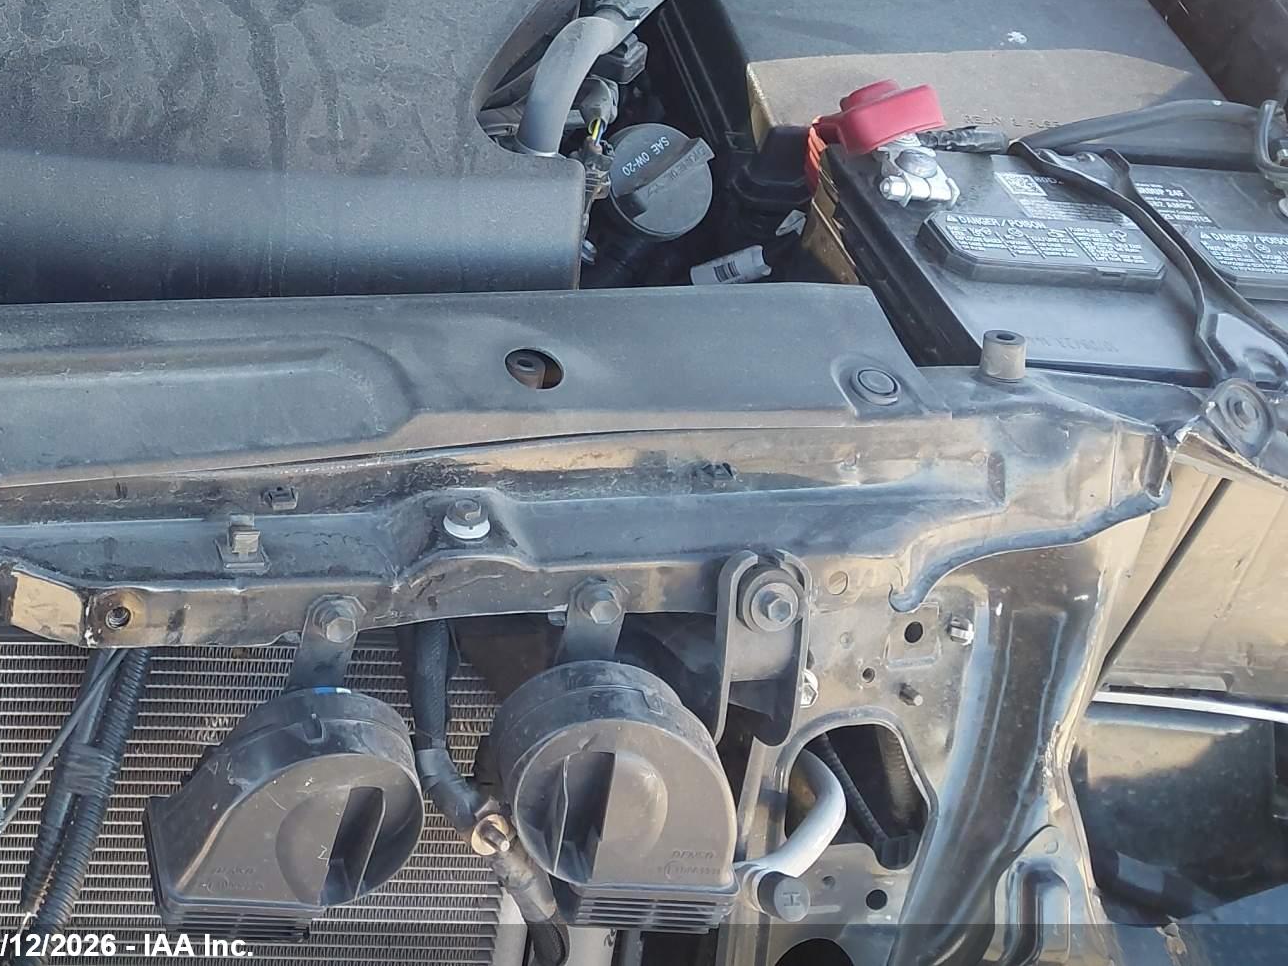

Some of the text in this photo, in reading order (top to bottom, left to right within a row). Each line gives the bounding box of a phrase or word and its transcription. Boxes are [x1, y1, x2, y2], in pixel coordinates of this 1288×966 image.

[650, 136, 670, 155] SAE
[622, 151, 650, 176] 0W-20
[958, 215, 1000, 227] DANGER
[1006, 219, 1047, 229] POISON
[1209, 232, 1252, 243] DANGER
